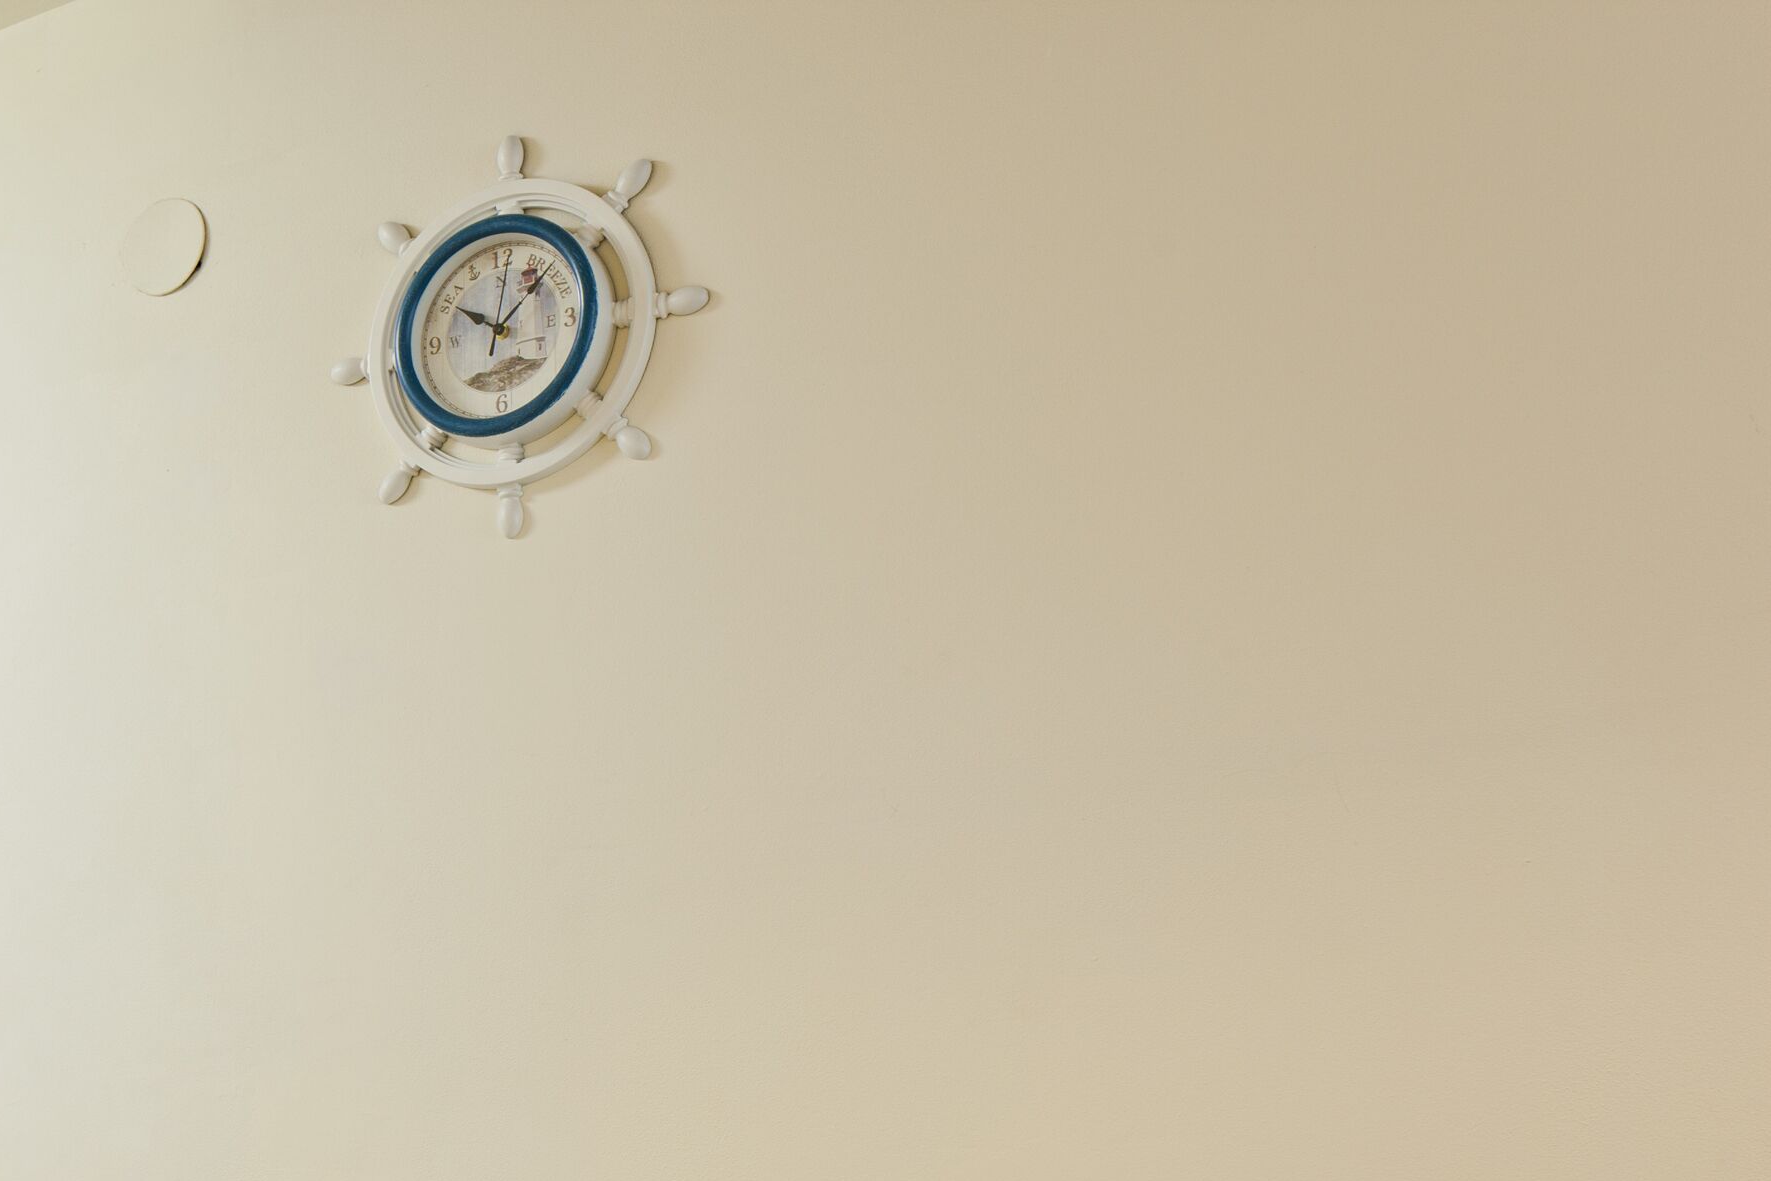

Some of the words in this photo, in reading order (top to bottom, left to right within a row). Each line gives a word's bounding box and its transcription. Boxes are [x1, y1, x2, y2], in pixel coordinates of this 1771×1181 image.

[492, 248, 513, 270] 12
[440, 284, 464, 315] SEA
[527, 253, 573, 299] BREEZE
[546, 314, 556, 328] E
[564, 306, 577, 327] 3
[429, 336, 442, 356] 9
[449, 335, 462, 349] W
[495, 393, 509, 414] 6
